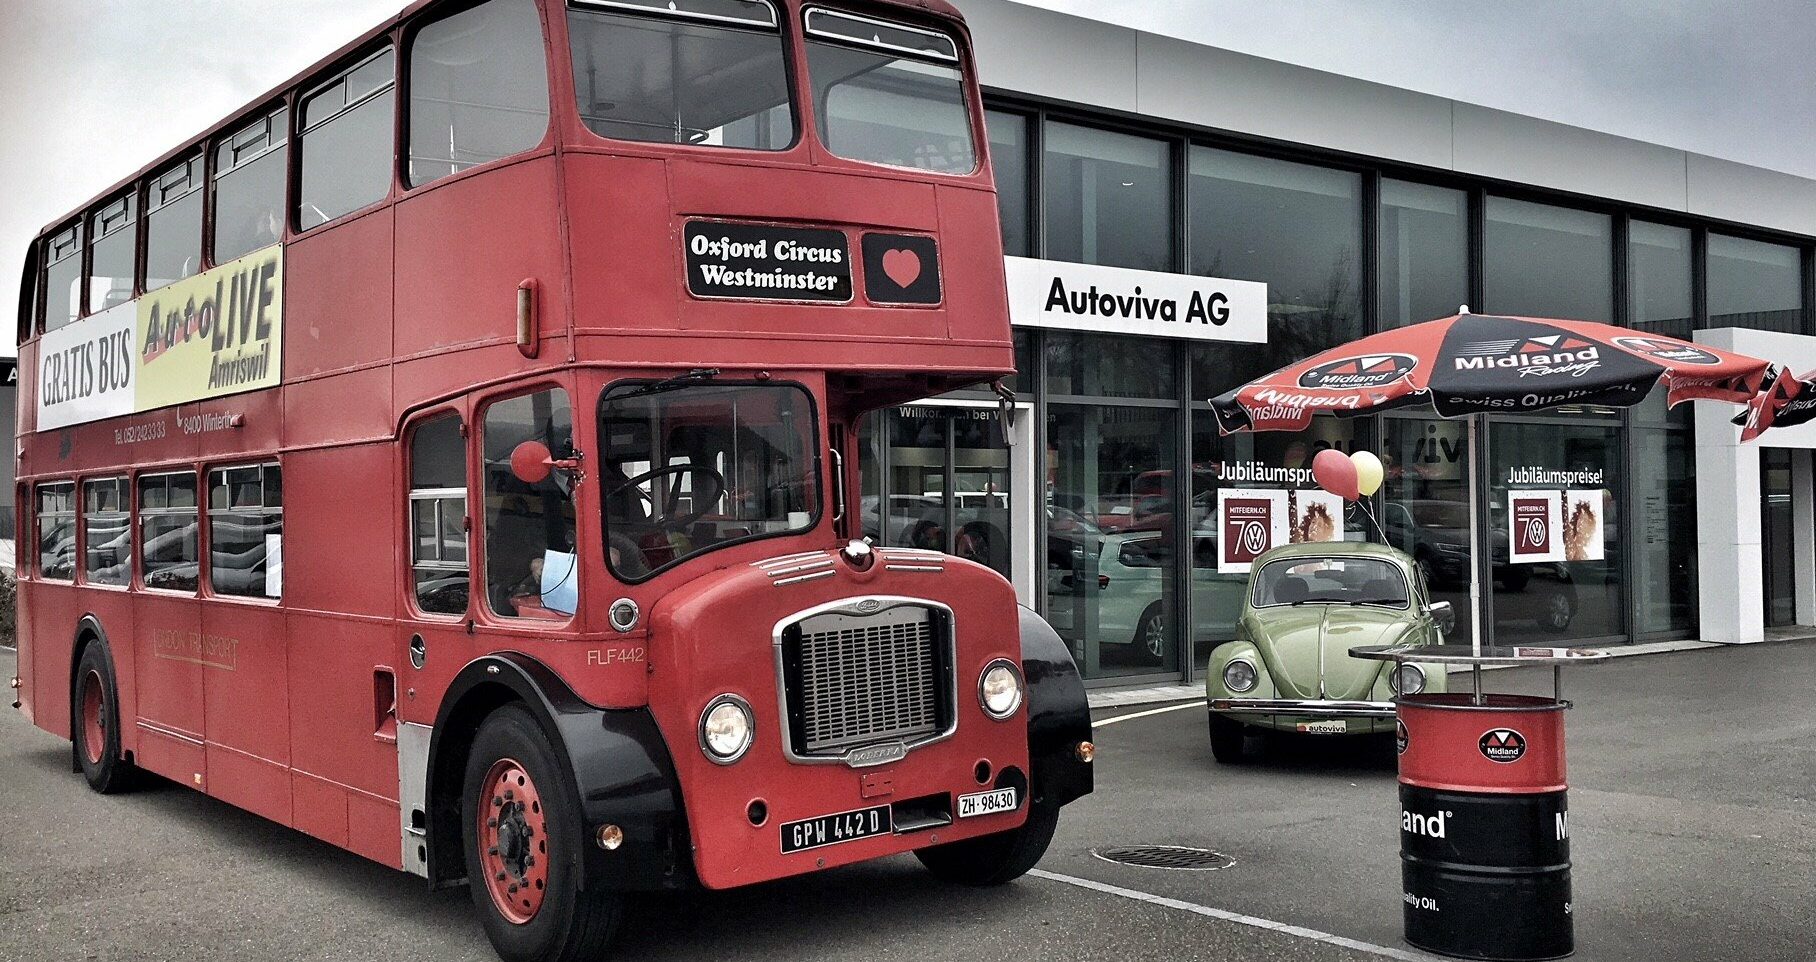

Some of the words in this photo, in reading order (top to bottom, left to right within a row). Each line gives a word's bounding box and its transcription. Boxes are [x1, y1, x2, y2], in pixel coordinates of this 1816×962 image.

[691, 234, 767, 261] Oxford
[774, 240, 842, 264] Circus
[700, 263, 838, 291] Westminster
[1045, 277, 1177, 322] Autoviva
[1185, 290, 1230, 326] AG
[42, 340, 94, 407] GRATIS
[99, 327, 131, 394] BUS
[208, 342, 271, 390] Amriswil
[1455, 346, 1600, 370] Midland
[1517, 360, 1602, 378] Racing
[1319, 372, 1389, 383] Midland
[1508, 466, 1603, 487] Jubiläumspreise!
[1487, 747, 1519, 755] Midland
[793, 824, 827, 847] GPW
[834, 812, 865, 839] 442
[870, 810, 880, 833] D
[1421, 897, 1440, 912] Oil.
